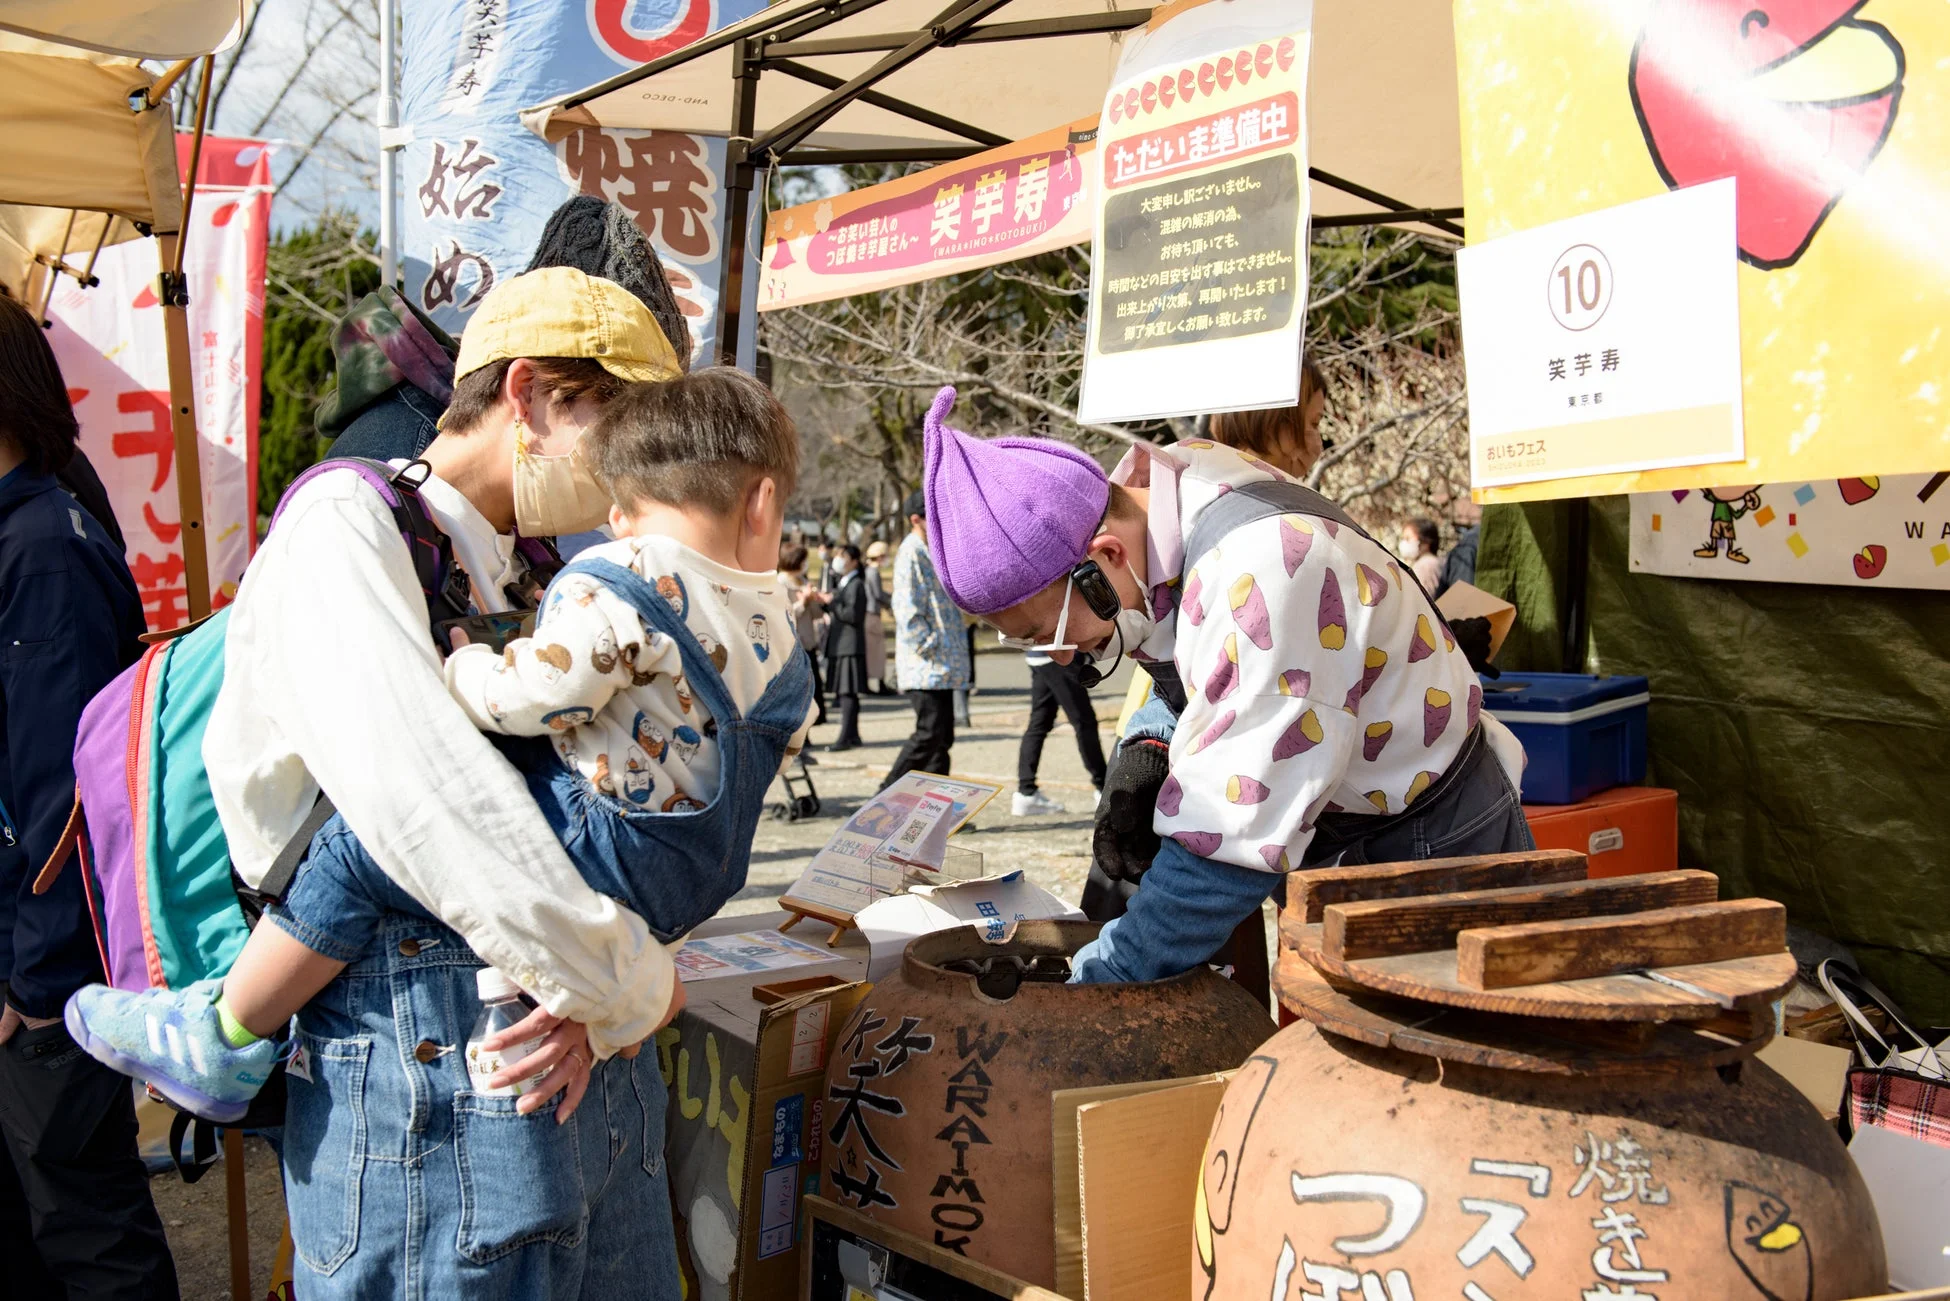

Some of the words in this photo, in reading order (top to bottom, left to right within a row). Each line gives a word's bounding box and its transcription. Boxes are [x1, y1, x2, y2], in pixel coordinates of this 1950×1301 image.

[1113, 101, 1289, 178] ただいま準備中
[930, 154, 1051, 246] 笑芋寿
[1141, 176, 1262, 214] 大変申し訳ございません。
[1160, 206, 1242, 236] 混雑の解消の為、
[1160, 233, 1240, 261] お待ち頂いても、
[1108, 250, 1293, 294] 時間などの目安を出す事はできません。
[1558, 259, 1601, 314] 10
[1549, 349, 1620, 381] 笑芋寿
[1568, 392, 1603, 408] 東京都
[1487, 440, 1546, 460] おいもフェス
[773, 1106, 787, 1159] なまもの
[808, 1099, 823, 1161] こわれもの
